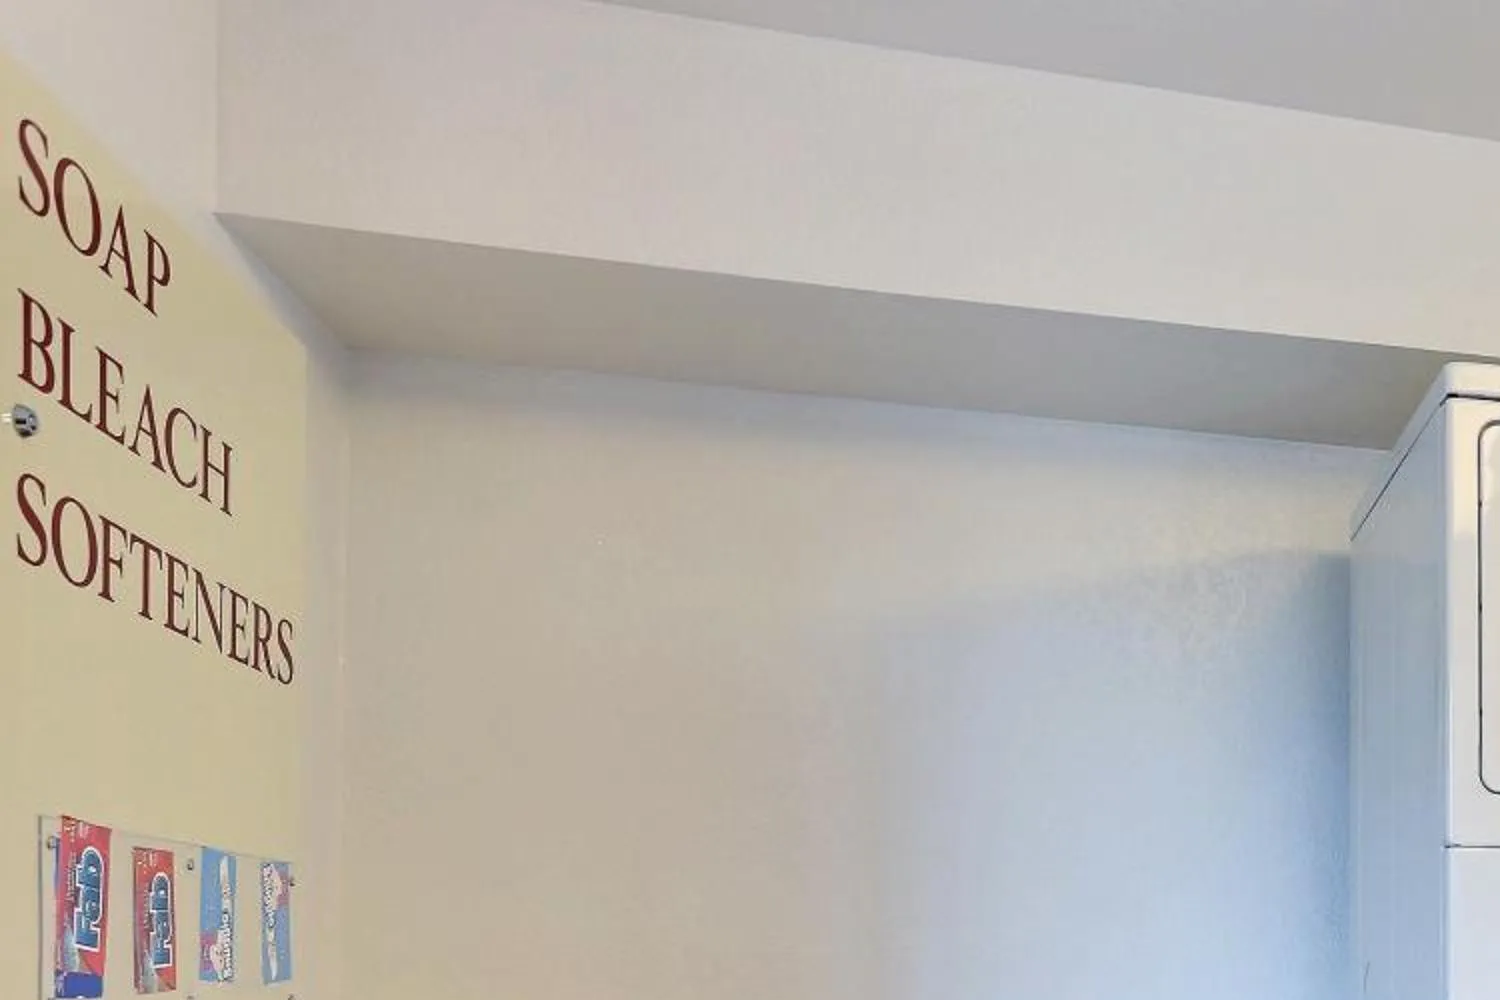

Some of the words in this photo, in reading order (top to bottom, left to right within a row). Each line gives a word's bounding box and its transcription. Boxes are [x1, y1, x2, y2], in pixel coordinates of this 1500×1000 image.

[18, 118, 171, 317] SOAP
[17, 287, 234, 517] BLEACH
[16, 473, 295, 686] SOFTENERS
[74, 846, 104, 951] Fab
[149, 871, 173, 968] Fab
